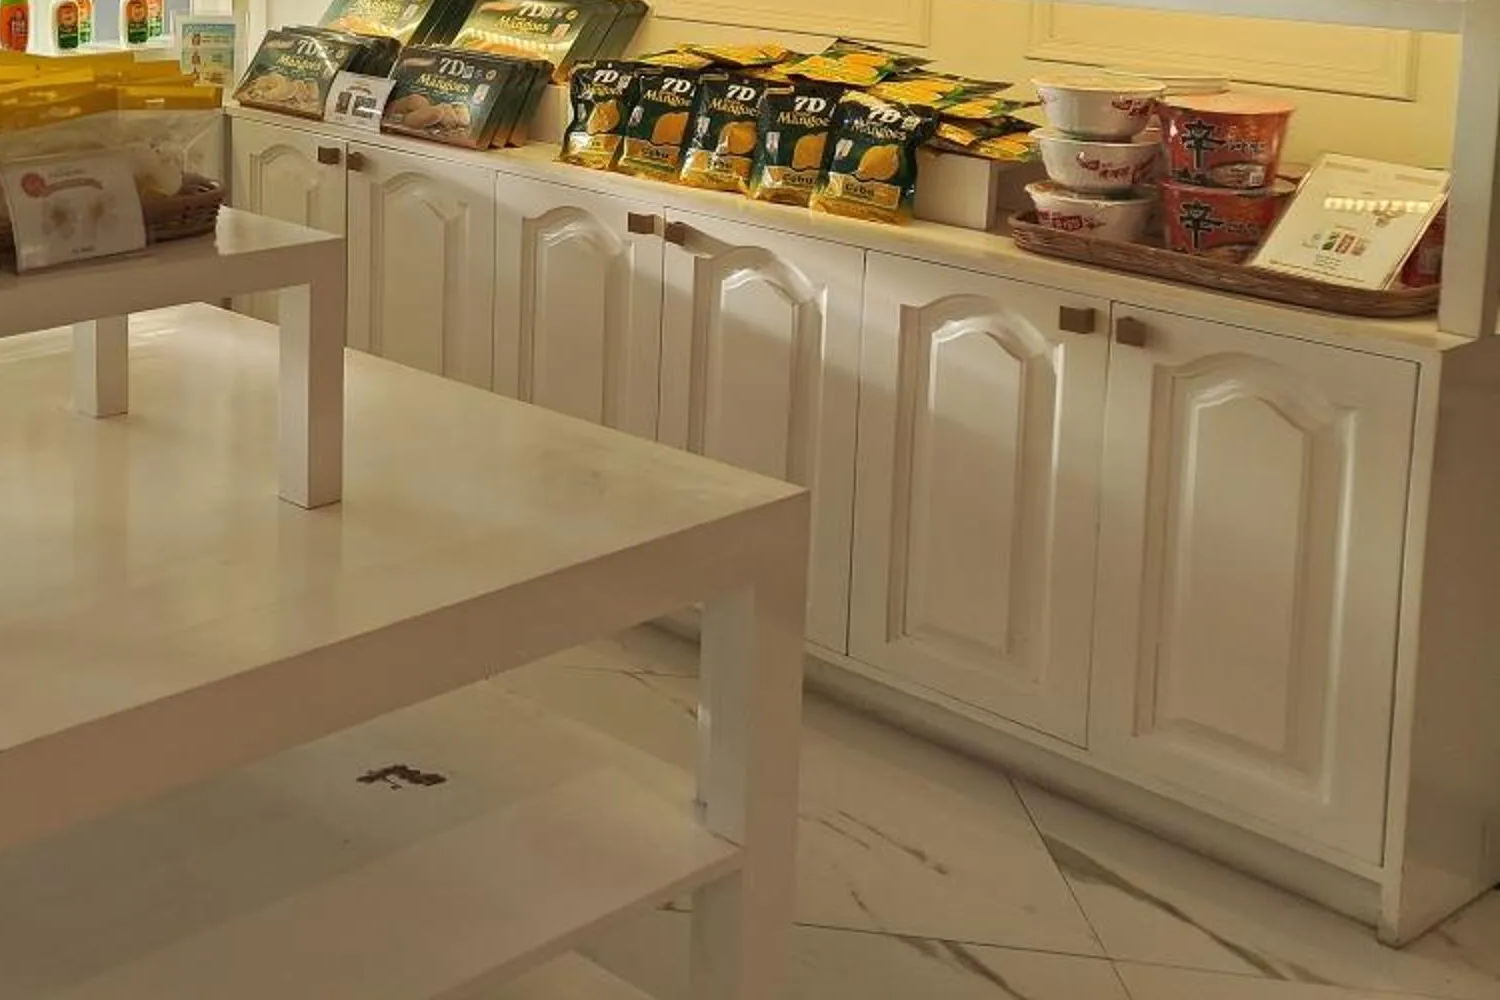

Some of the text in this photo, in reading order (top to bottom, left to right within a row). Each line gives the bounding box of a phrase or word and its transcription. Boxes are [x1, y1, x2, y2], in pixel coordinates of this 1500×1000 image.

[518, 1, 547, 18] 7D
[296, 40, 318, 56] 7D
[439, 57, 465, 76] 7D
[593, 69, 619, 83] 7D
[661, 77, 691, 93] 7D
[726, 84, 756, 101] 7D
[708, 97, 761, 117] Mangoe
[793, 96, 827, 113] 7D
[777, 110, 830, 128] Mangoe
